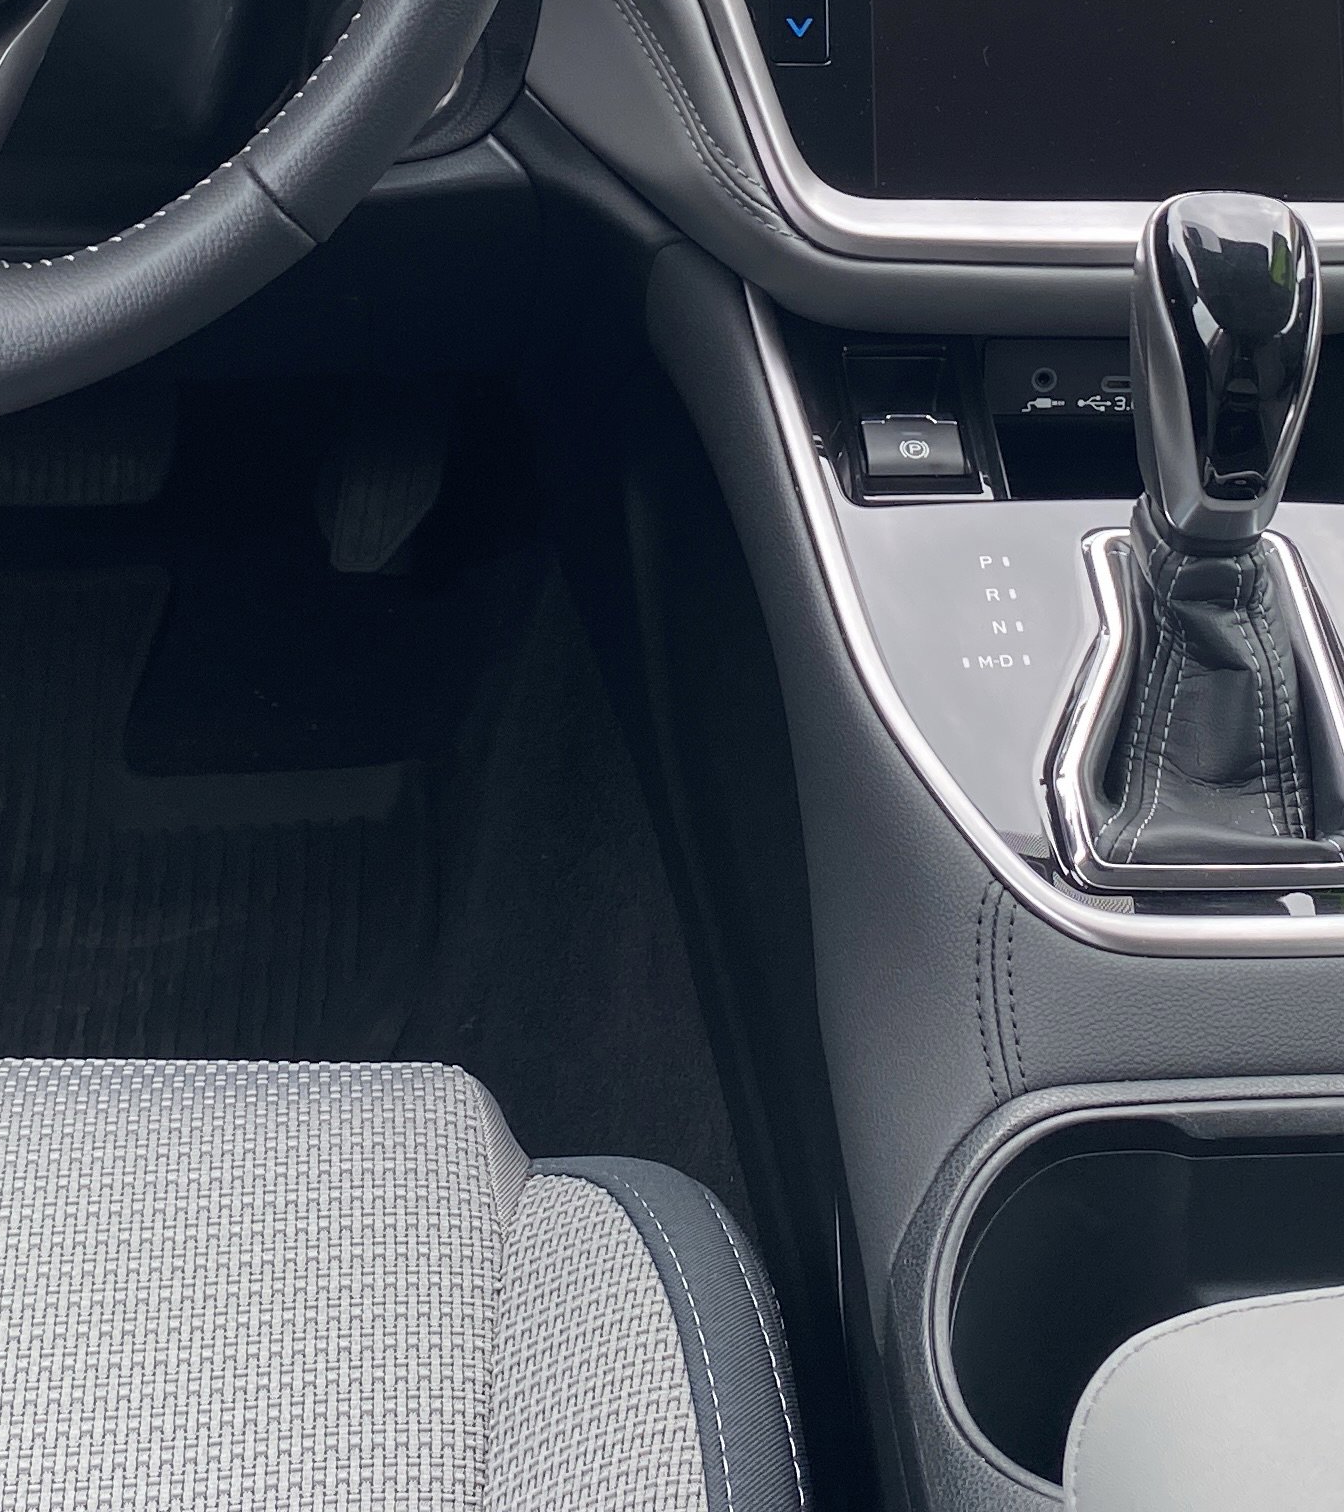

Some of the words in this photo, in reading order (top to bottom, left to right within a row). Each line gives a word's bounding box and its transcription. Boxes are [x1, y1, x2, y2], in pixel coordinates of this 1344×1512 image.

[979, 555, 993, 569] P
[985, 587, 1001, 602] R
[991, 619, 1008, 635] N
